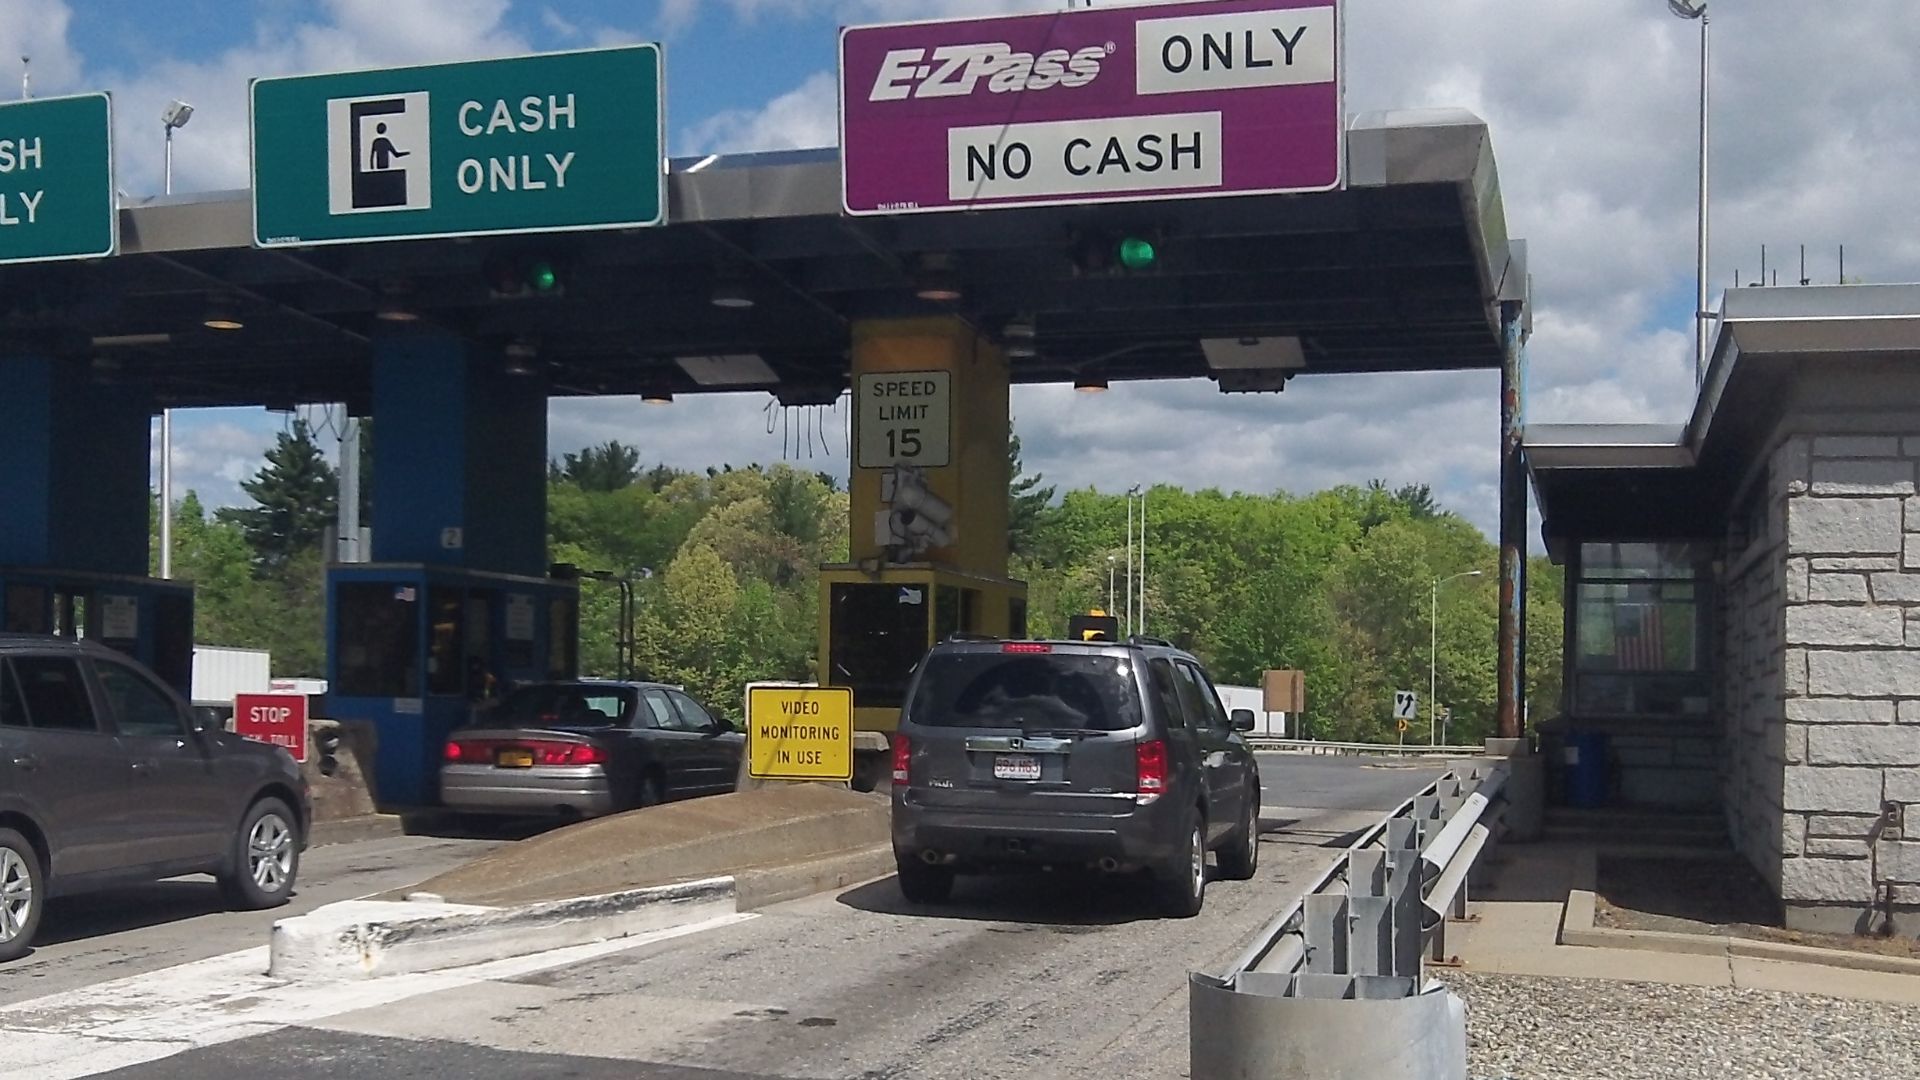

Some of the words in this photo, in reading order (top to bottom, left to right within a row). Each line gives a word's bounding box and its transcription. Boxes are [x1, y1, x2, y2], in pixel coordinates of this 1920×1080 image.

[1162, 26, 1307, 73] ONLY
[459, 94, 575, 136] CASH
[966, 142, 1032, 182] NO
[1064, 132, 1201, 176] CASH
[458, 152, 575, 193] ONLY
[0, 190, 43, 225] LY
[873, 381, 936, 397] SPEED
[879, 405, 928, 420] LIMIT
[886, 429, 922, 458] 15
[250, 706, 291, 722] STOP
[781, 701, 819, 715] VIDEO
[761, 726, 839, 740] MONITORING
[777, 751, 790, 763] IN
[797, 751, 822, 764] USE
